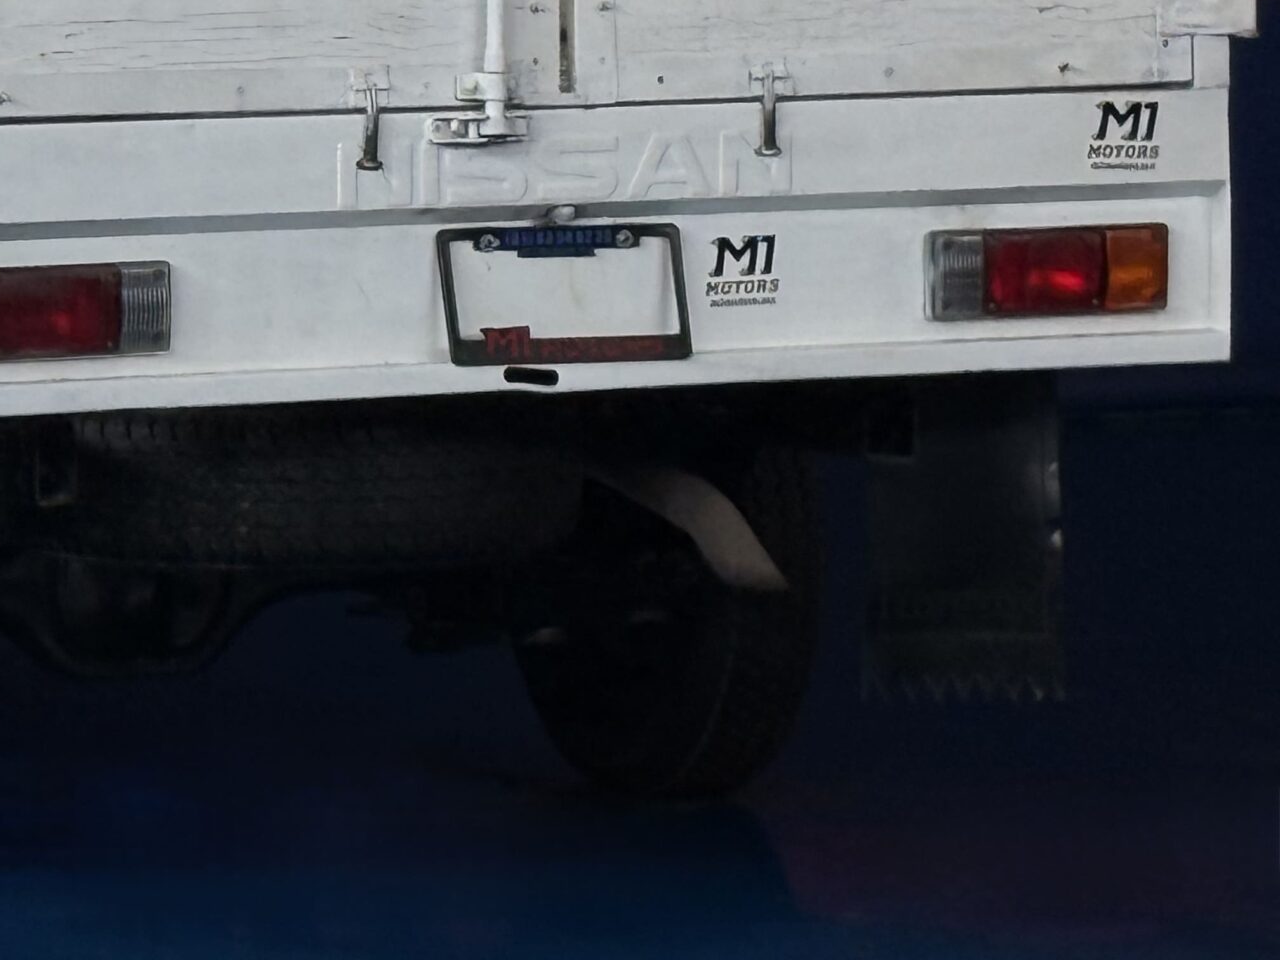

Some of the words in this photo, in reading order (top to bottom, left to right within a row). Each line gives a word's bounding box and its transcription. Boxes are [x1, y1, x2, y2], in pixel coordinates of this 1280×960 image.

[1087, 144, 1160, 159] MOTORS
[336, 133, 793, 208] NISSAN
[705, 279, 780, 296] MOTORS
